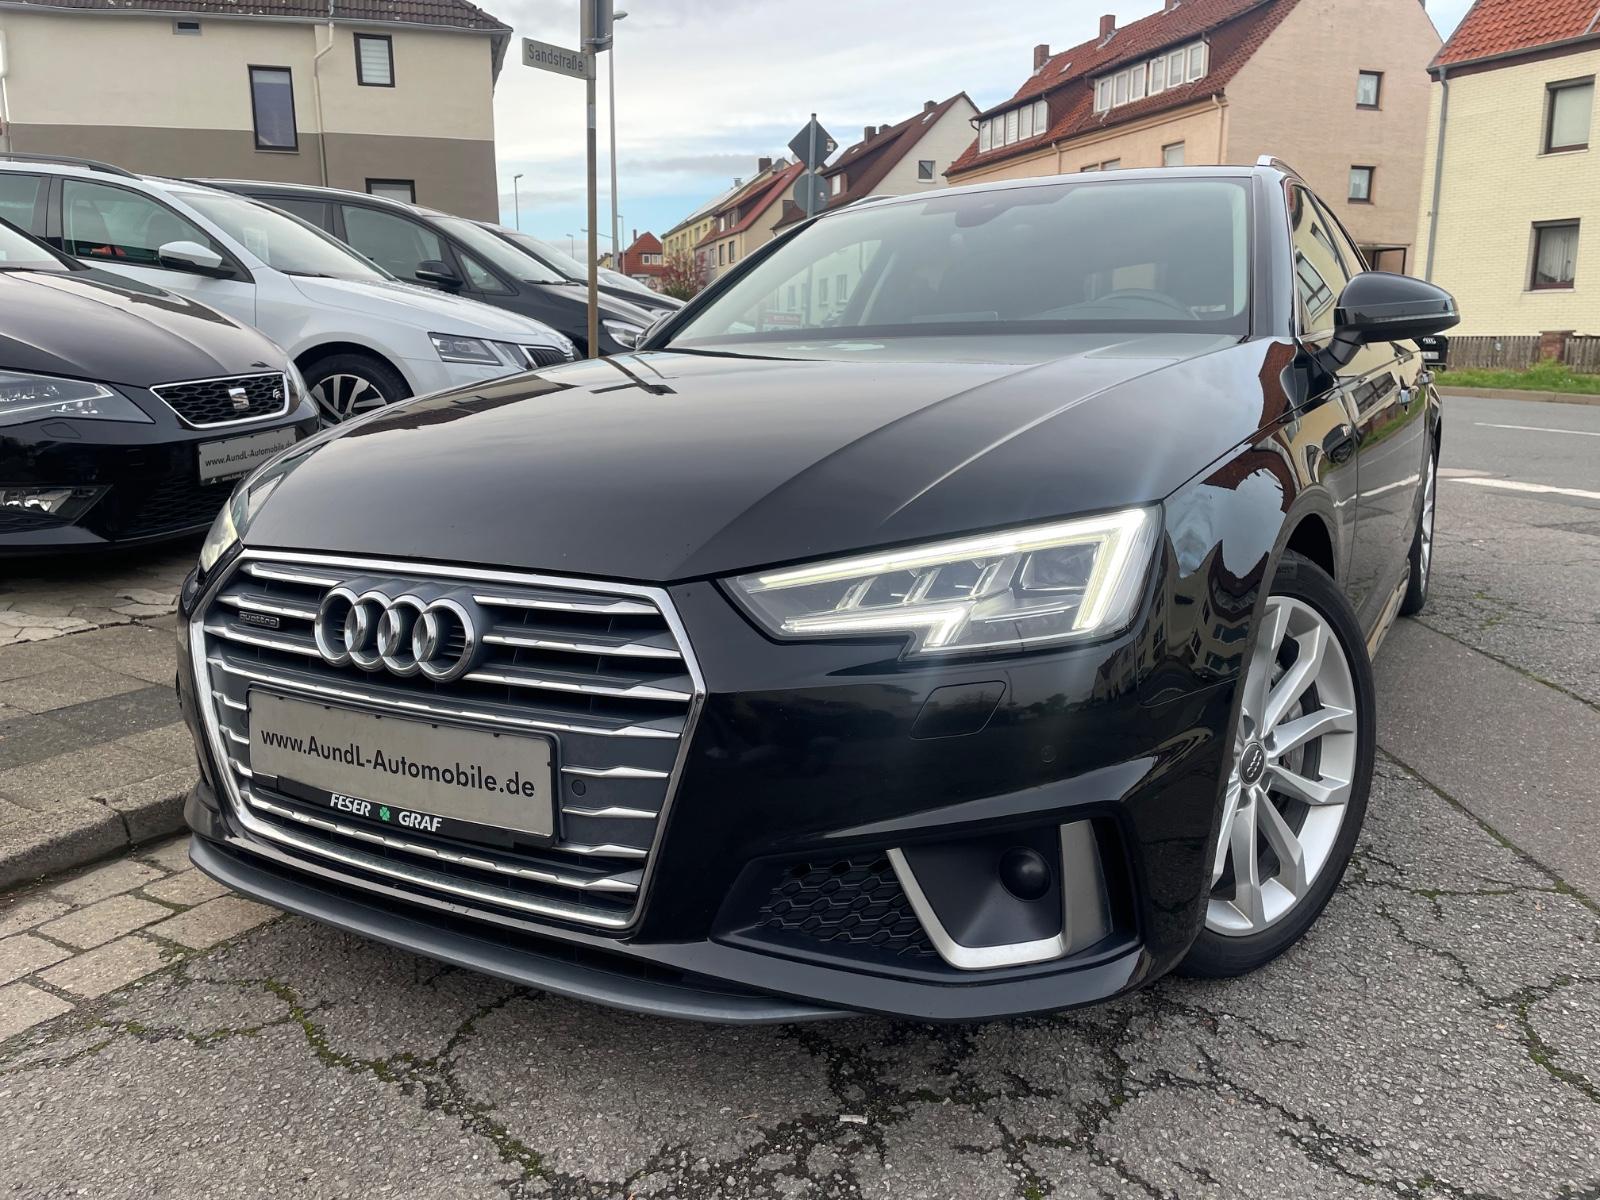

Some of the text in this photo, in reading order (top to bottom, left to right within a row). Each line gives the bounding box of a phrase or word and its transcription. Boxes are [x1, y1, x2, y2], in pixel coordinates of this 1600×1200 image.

[528, 43, 584, 72] Sandstraße
[261, 730, 535, 797] www.AundL-Automobile.de
[330, 793, 442, 833] FESER GRAF
